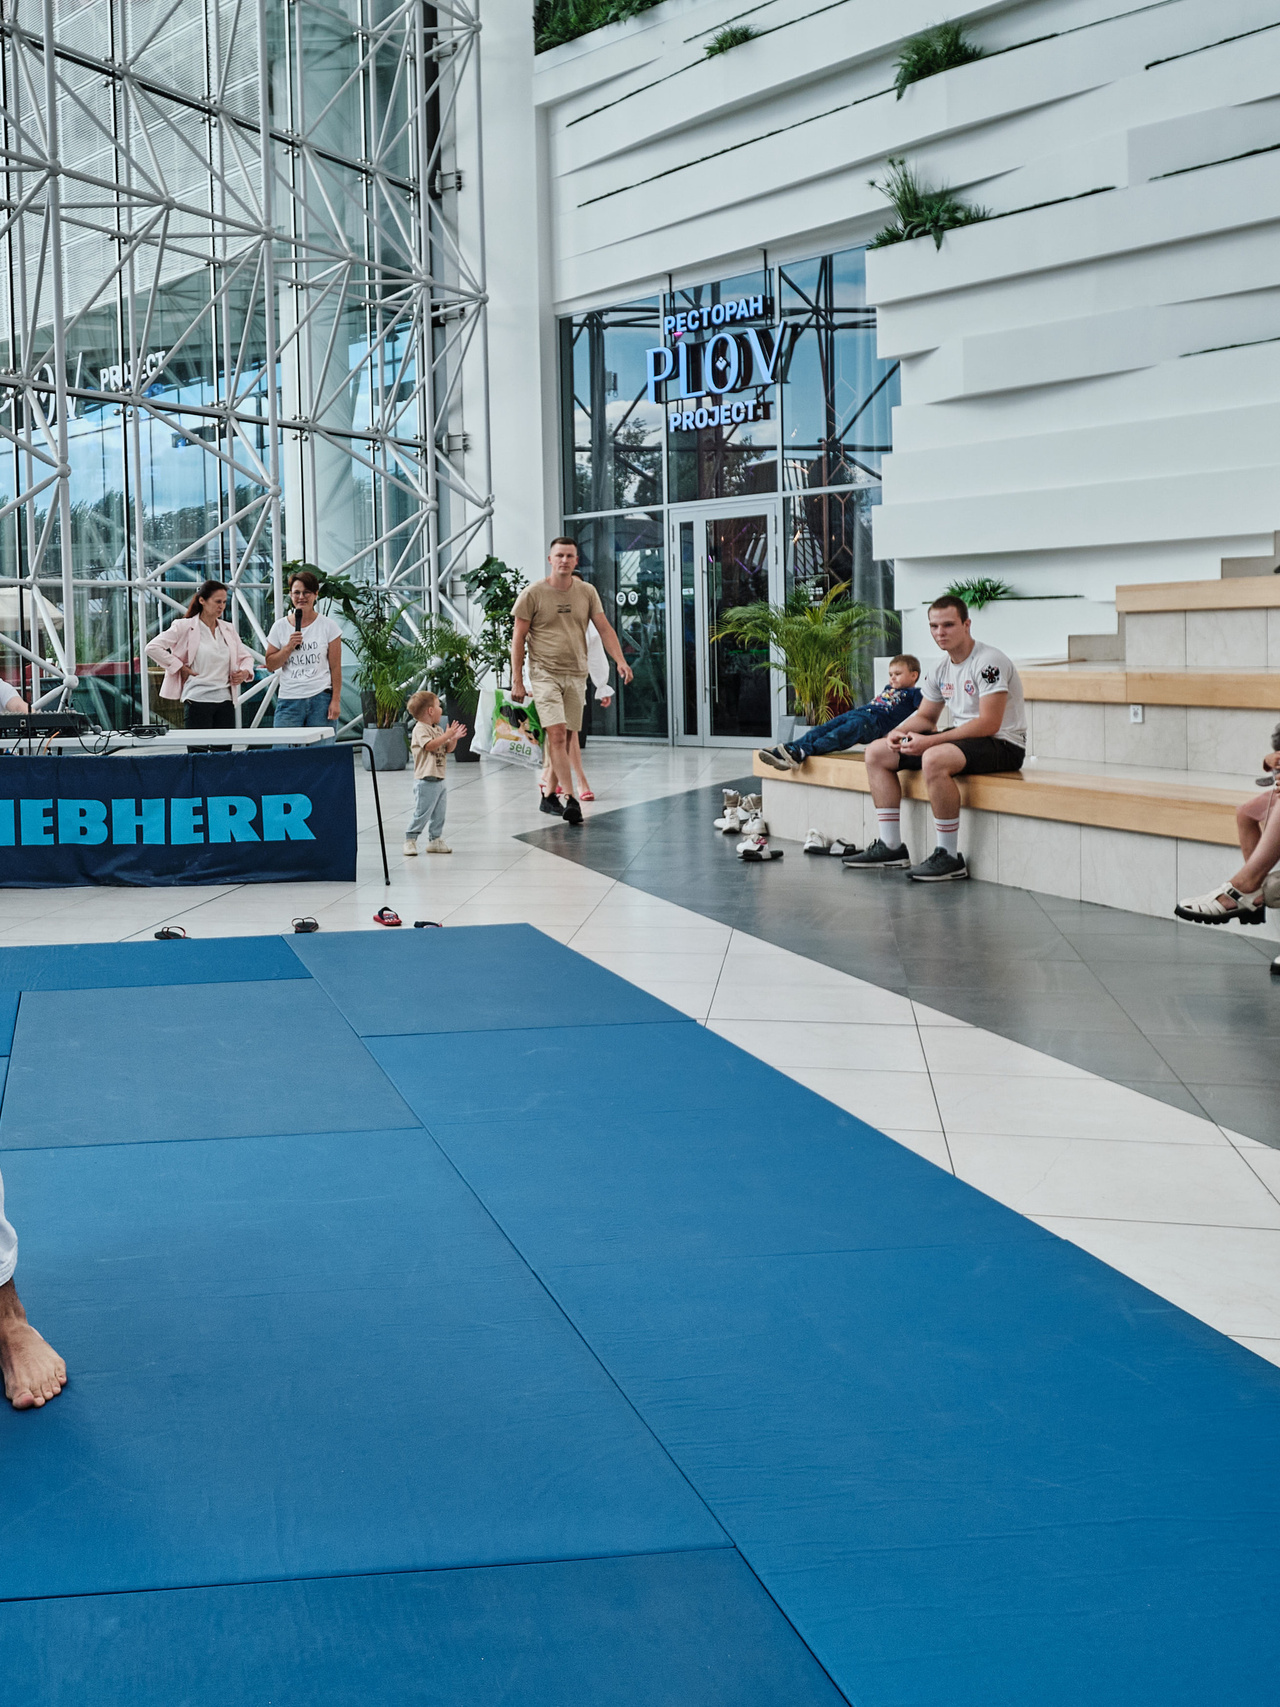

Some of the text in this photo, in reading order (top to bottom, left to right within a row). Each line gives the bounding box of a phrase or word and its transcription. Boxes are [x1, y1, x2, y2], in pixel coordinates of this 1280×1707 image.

[664, 294, 764, 336] РЕСТОРАН
[646, 320, 787, 405] PLOV
[670, 400, 757, 432] PROJECT
[509, 741, 532, 755] sela
